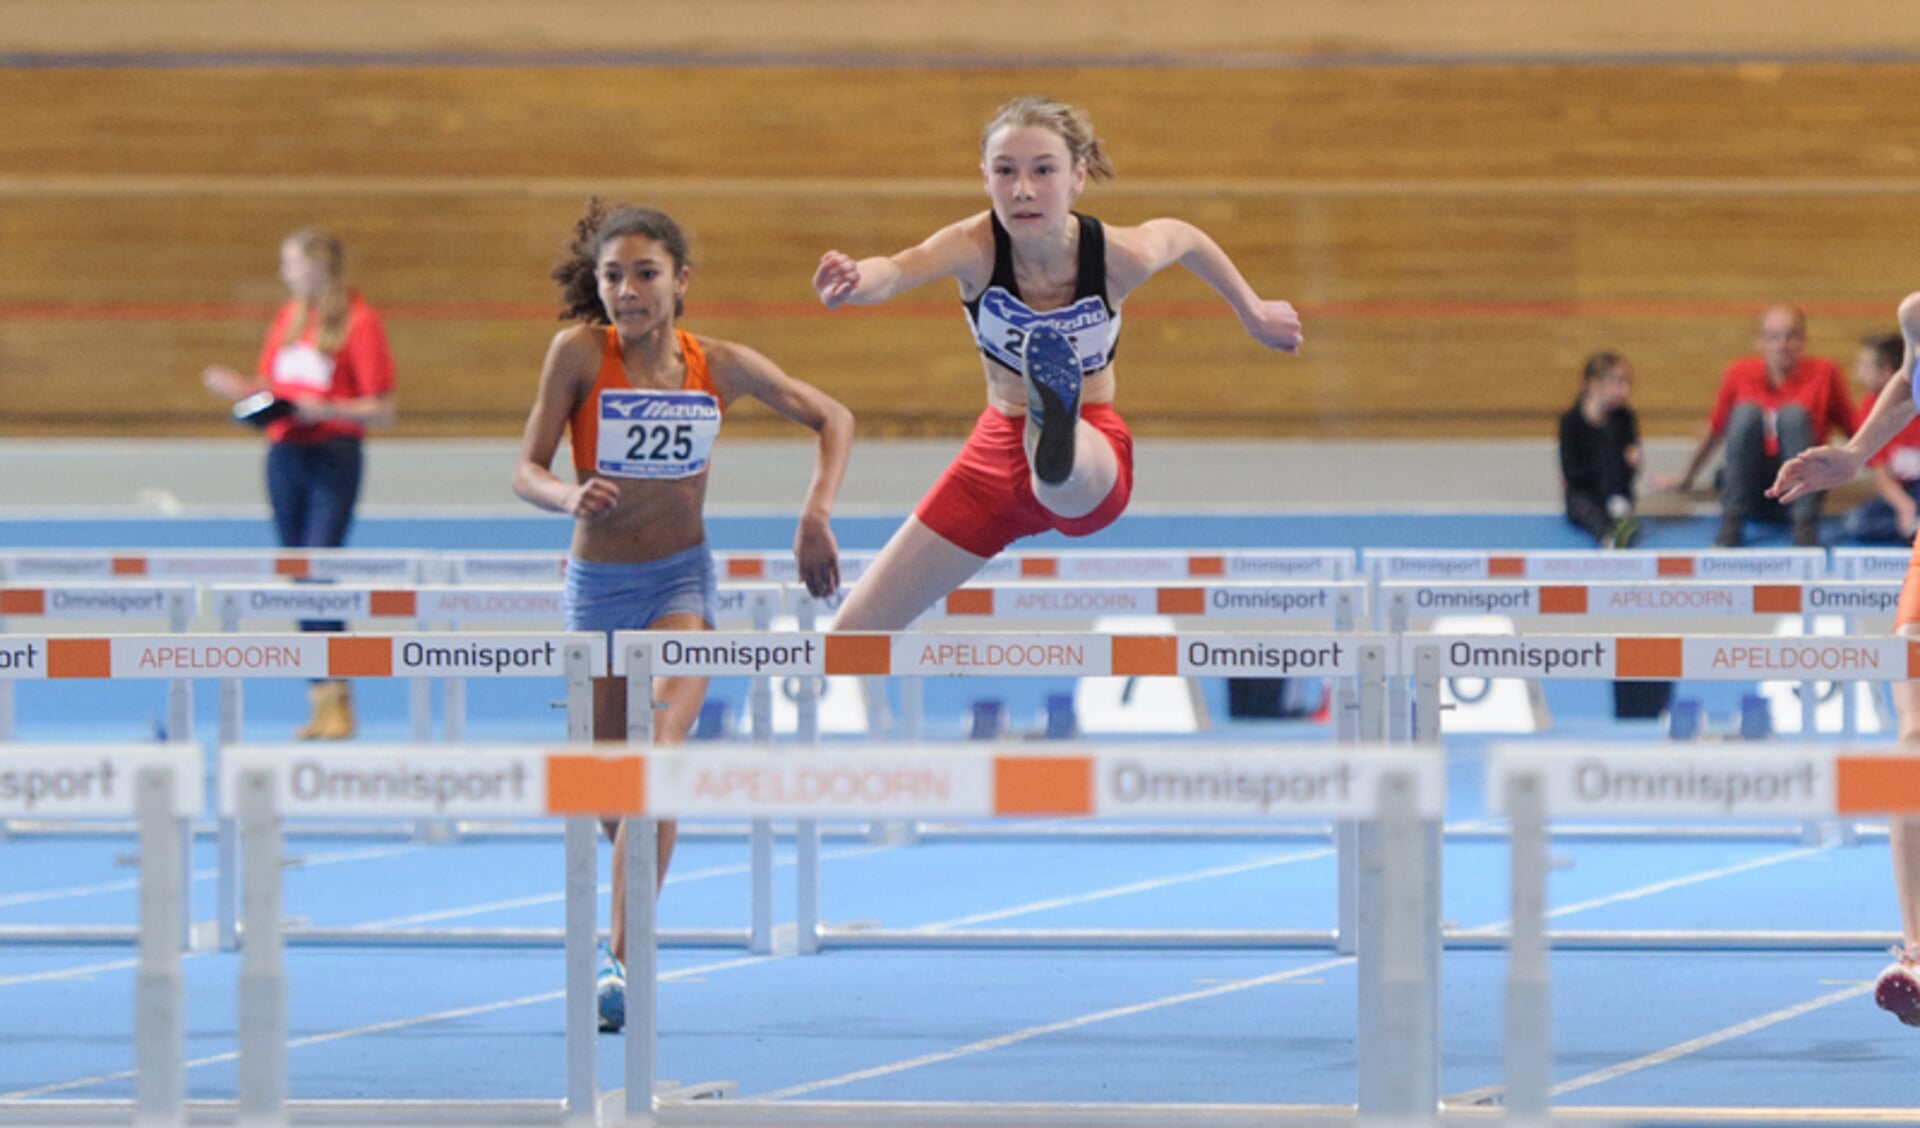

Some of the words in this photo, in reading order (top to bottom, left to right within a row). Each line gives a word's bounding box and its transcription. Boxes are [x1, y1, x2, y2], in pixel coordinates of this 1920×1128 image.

[626, 424, 692, 461] 225
[52, 591, 164, 613] Omnisport
[250, 591, 361, 613] Omnisport
[1014, 593, 1138, 610] APELDOORN
[1213, 590, 1327, 615] Omnisport
[1416, 587, 1530, 612] Omnisport
[1608, 590, 1733, 608] APELDOORN
[139, 646, 301, 669] APELDOORN
[402, 642, 555, 673] Omnisport
[661, 640, 815, 671] Omnisport
[919, 644, 1084, 667] APELDOORN
[1188, 641, 1343, 673] Omnisport
[1449, 642, 1605, 673] Omnisport
[1711, 646, 1880, 669] APELDOORN
[290, 761, 527, 806] Omnisport
[693, 767, 949, 804] APELDOORN
[1113, 761, 1353, 812] Omnisport
[1575, 762, 1818, 811] Omnisport
